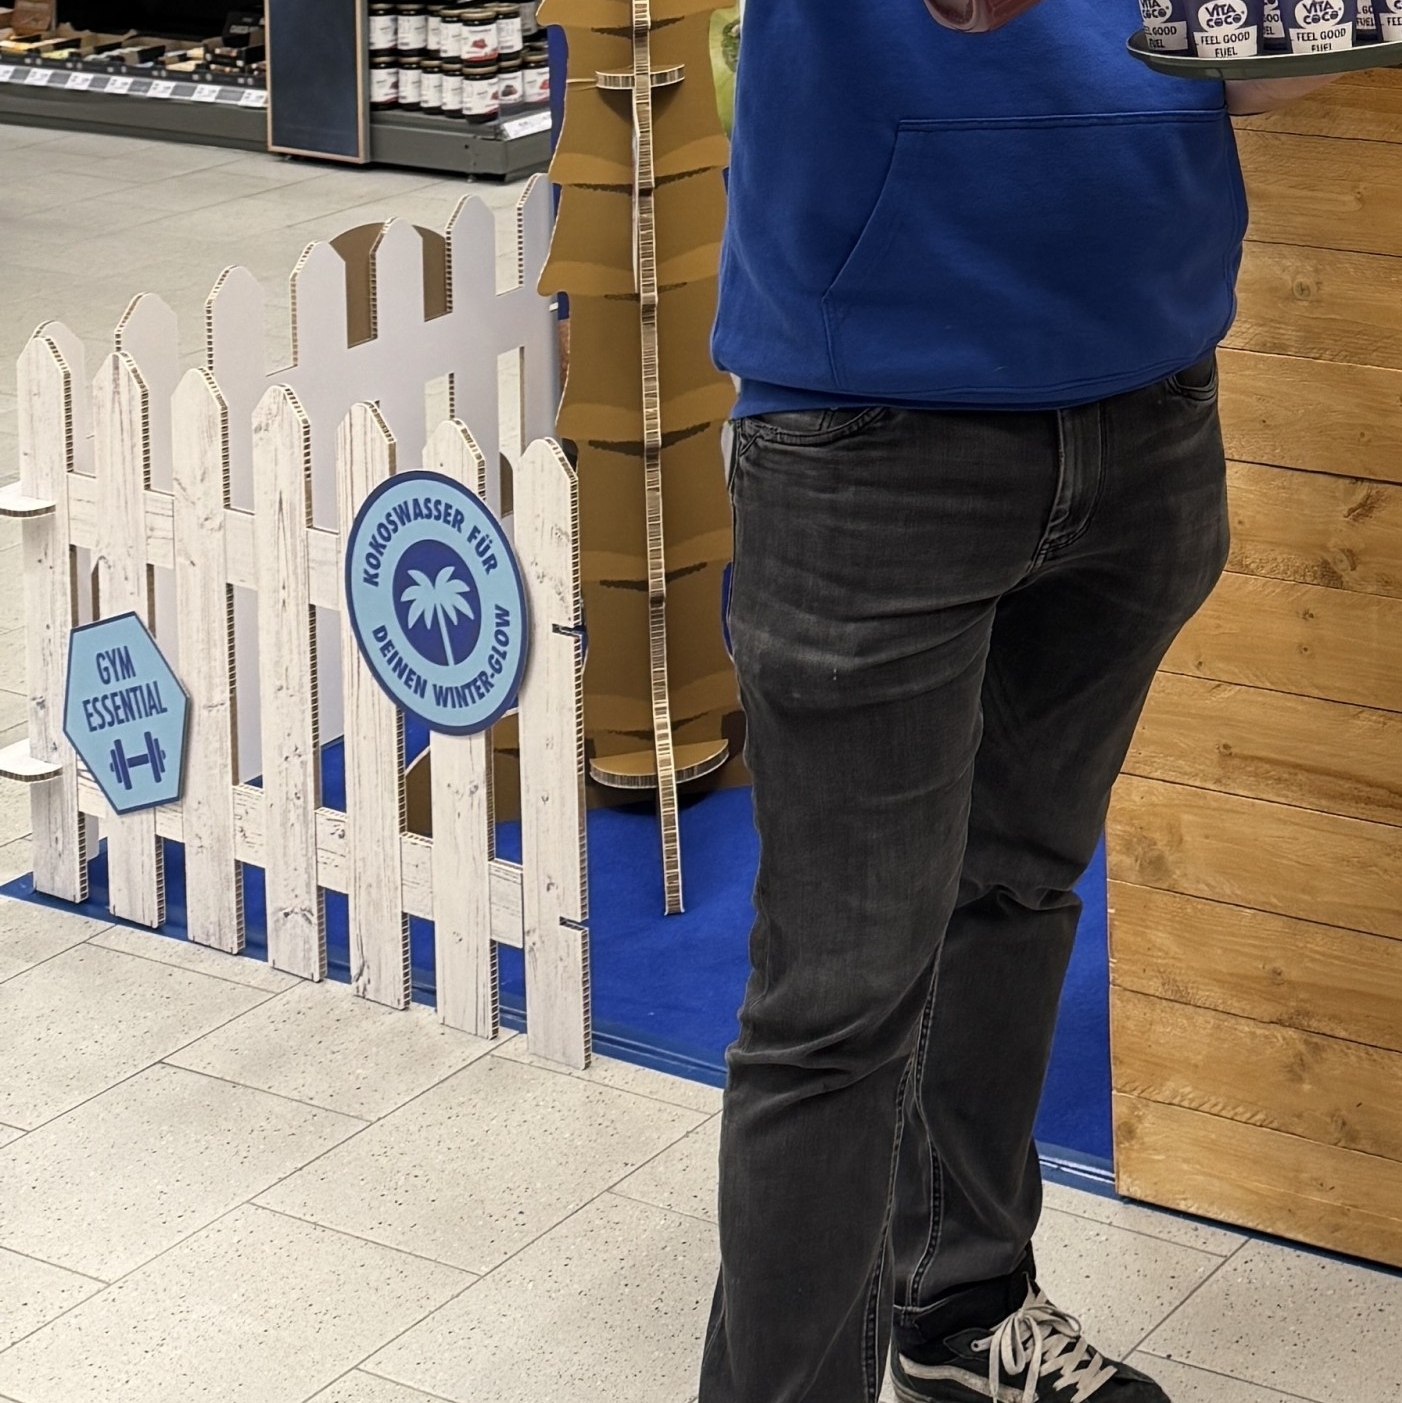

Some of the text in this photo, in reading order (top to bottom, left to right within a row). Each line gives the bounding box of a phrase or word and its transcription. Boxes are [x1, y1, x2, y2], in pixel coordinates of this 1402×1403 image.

[1142, 8, 1167, 19] COCO
[1205, 4, 1236, 17] VITA
[1302, 0, 1334, 14] VITA
[1206, 14, 1242, 28] COCO
[1304, 10, 1339, 25] COCO
[1152, 26, 1177, 35] GOOD
[1297, 28, 1346, 41] FEEL GOOD
[1201, 31, 1250, 45] FEEL GOOD
[1215, 47, 1238, 57] FUEL
[1312, 43, 1332, 51] FUEL
[363, 497, 498, 588] KOKOSWASSER FÜR
[372, 604, 510, 709] DEINEN WINTER-GLOW
[96, 646, 136, 685] GYM
[82, 680, 168, 732] ESSENTIAL
